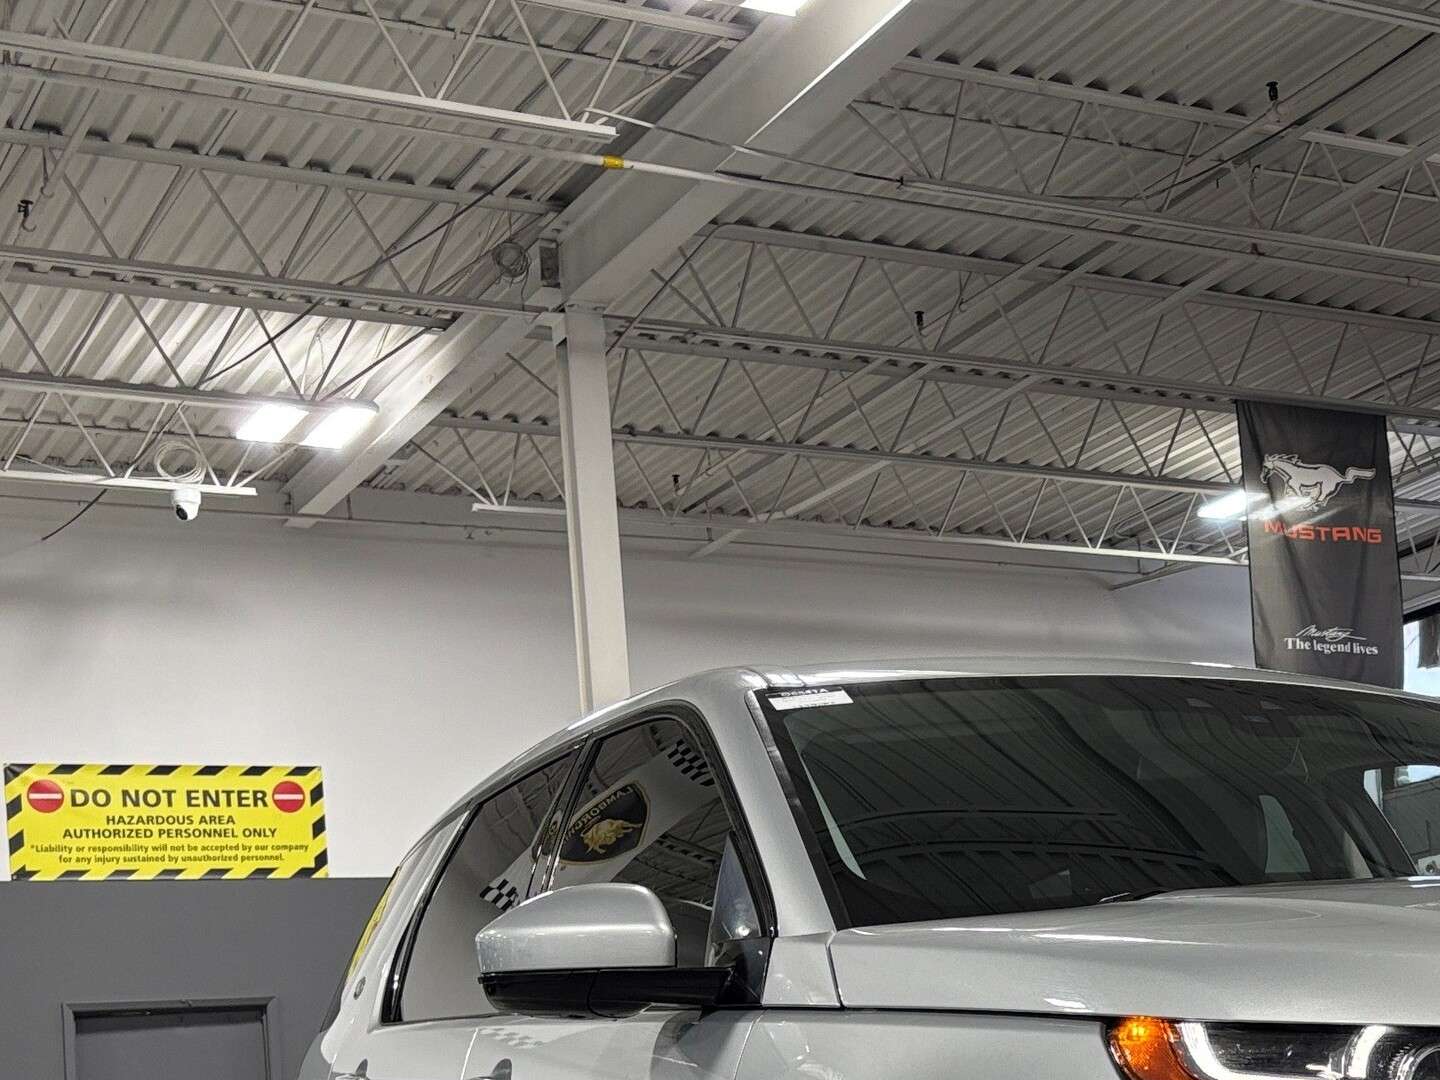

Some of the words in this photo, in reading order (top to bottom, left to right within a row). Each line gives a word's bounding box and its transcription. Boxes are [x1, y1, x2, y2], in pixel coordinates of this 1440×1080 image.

[1264, 521, 1382, 543] MUSTANG
[1283, 637, 1312, 650] The
[1313, 639, 1351, 655] legend
[1353, 642, 1379, 655] lives
[71, 789, 111, 808] DO
[121, 789, 176, 808] NOT
[186, 789, 268, 808] ENTER
[106, 815, 194, 825] HAZARDOUS
[198, 815, 236, 825] AREA
[62, 828, 153, 839] AUTHORIZED
[158, 828, 238, 838] PERSONNEL
[242, 828, 277, 838] ONLY
[88, 844, 149, 854] responsibility
[151, 843, 168, 851] will
[187, 843, 198, 851] be
[200, 843, 240, 853] accepted
[241, 843, 252, 853] by
[270, 844, 309, 853] company
[59, 855, 72, 863] for
[75, 856, 92, 864] any
[94, 855, 121, 864] injury
[123, 854, 166, 863] sustained
[168, 854, 179, 863] by
[181, 854, 238, 862] unauthorized
